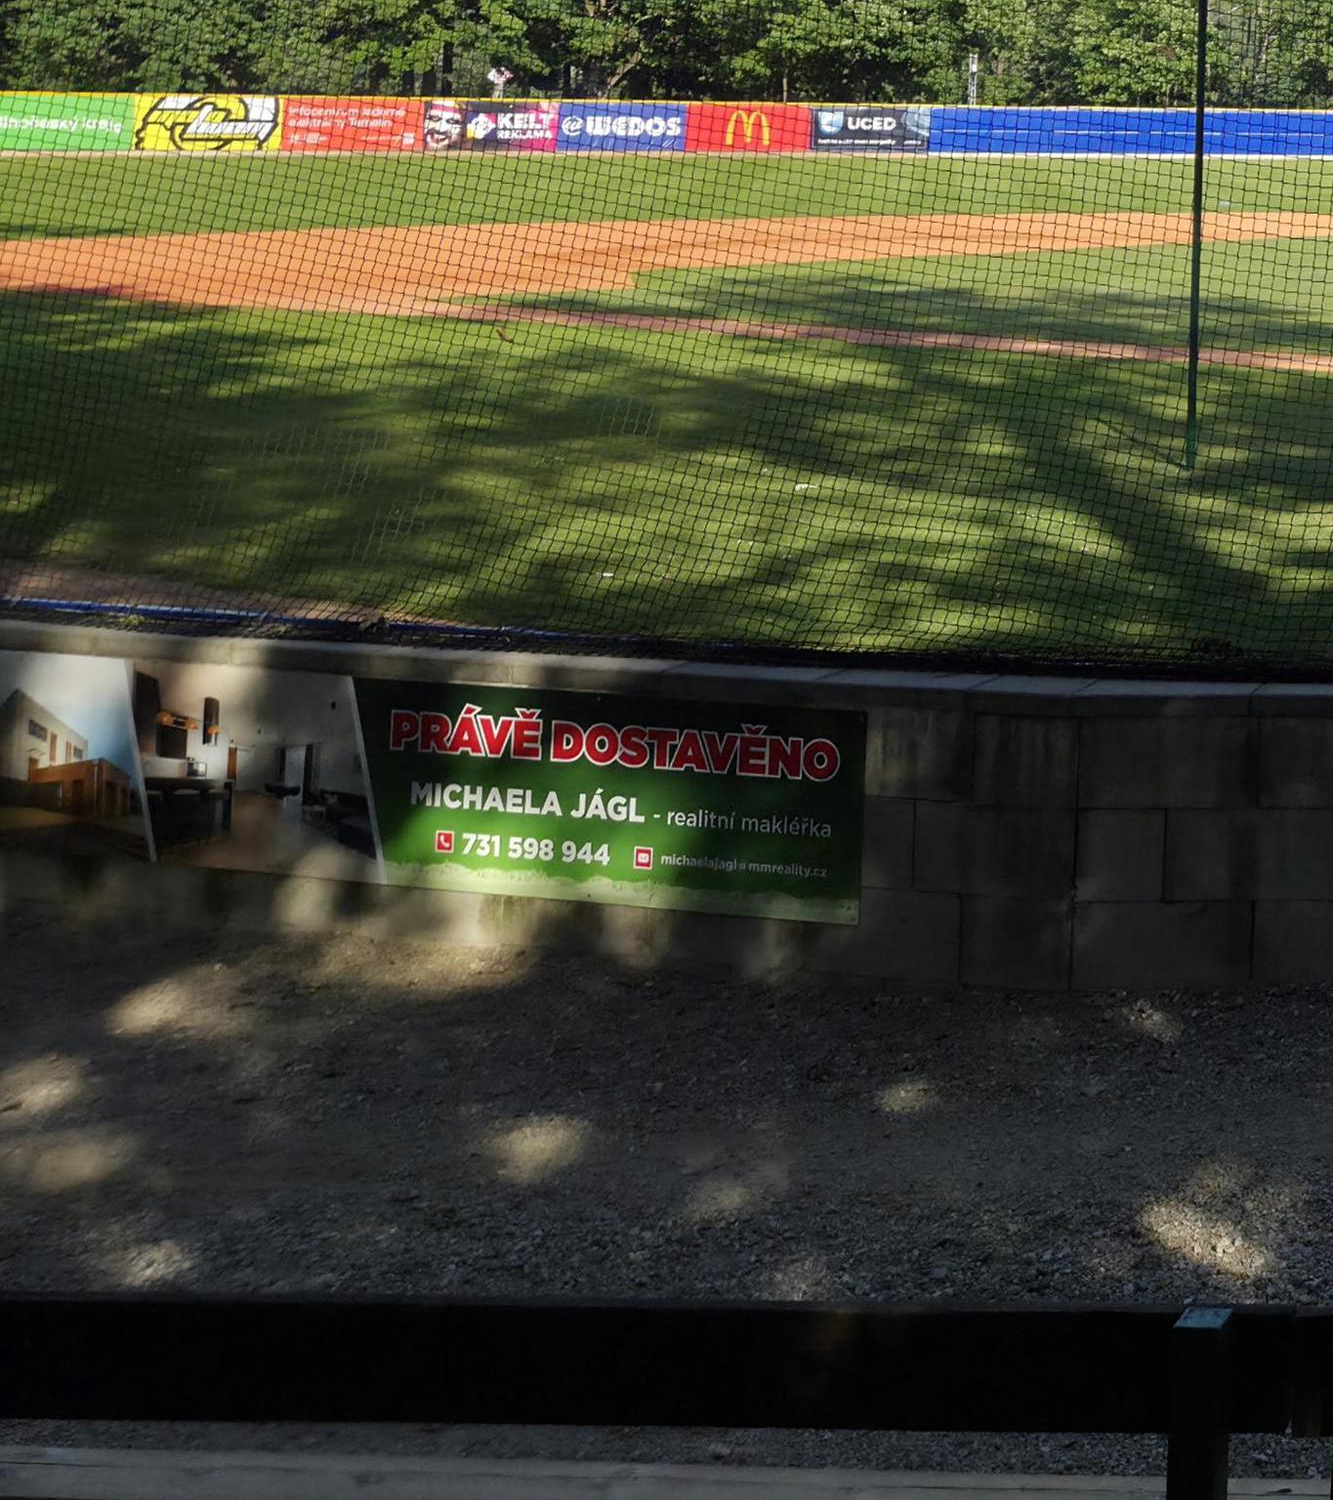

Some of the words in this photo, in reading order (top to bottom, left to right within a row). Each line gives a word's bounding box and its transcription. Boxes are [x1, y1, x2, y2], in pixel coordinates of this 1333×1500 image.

[498, 114, 552, 129] KELT
[585, 115, 682, 138] WEDOS
[847, 116, 897, 131] UCED
[390, 703, 543, 761] PRÁVĚ
[550, 719, 840, 782] DOSTAVĚNO
[410, 781, 563, 816] MICHAELA
[570, 787, 646, 823] JÁGL
[666, 810, 735, 830] realitní
[741, 817, 832, 838] makléřka
[462, 833, 501, 857] 731
[507, 836, 554, 861] 598
[561, 840, 611, 866] 944
